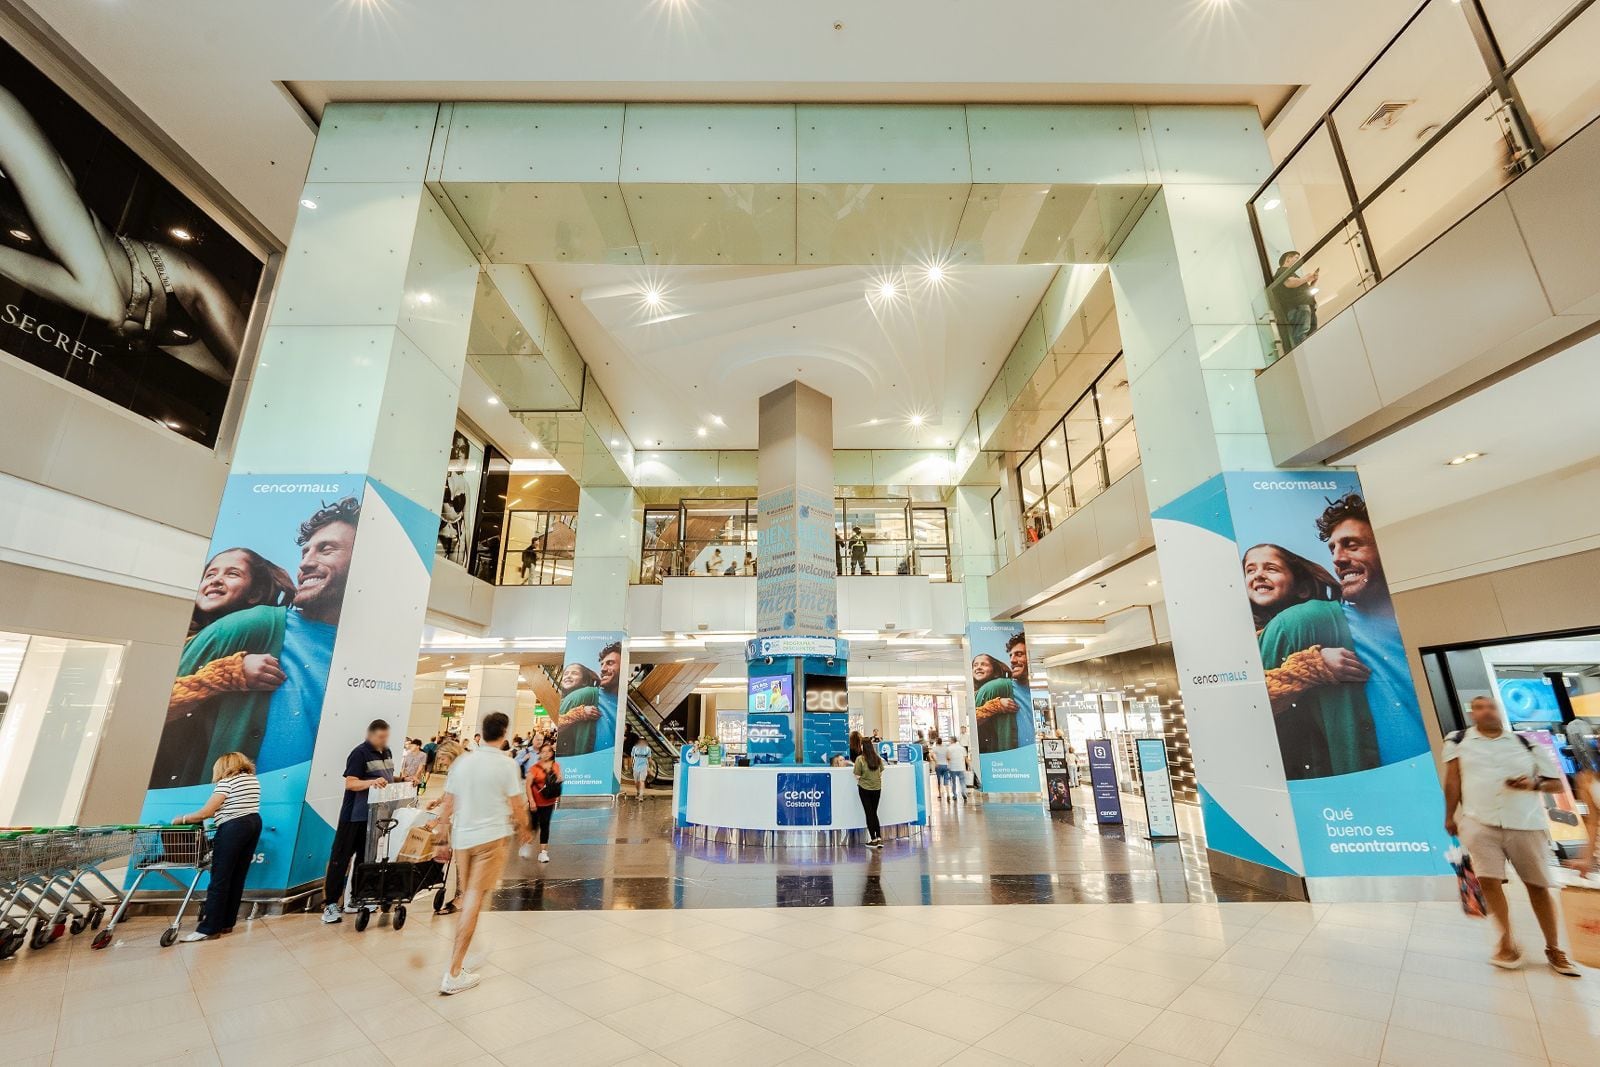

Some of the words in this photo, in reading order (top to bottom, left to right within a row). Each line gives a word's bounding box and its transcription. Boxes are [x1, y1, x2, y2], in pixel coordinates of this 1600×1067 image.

[1, 304, 103, 366] SECRET
[758, 563, 796, 580] welcome
[797, 563, 837, 580] welcome
[784, 790, 821, 800] cenco
[785, 800, 821, 808] Costanera
[1322, 807, 1354, 822] Qué
[1326, 823, 1373, 837] bueno
[1376, 825, 1394, 836] es
[1330, 840, 1430, 853] encontrarnos
